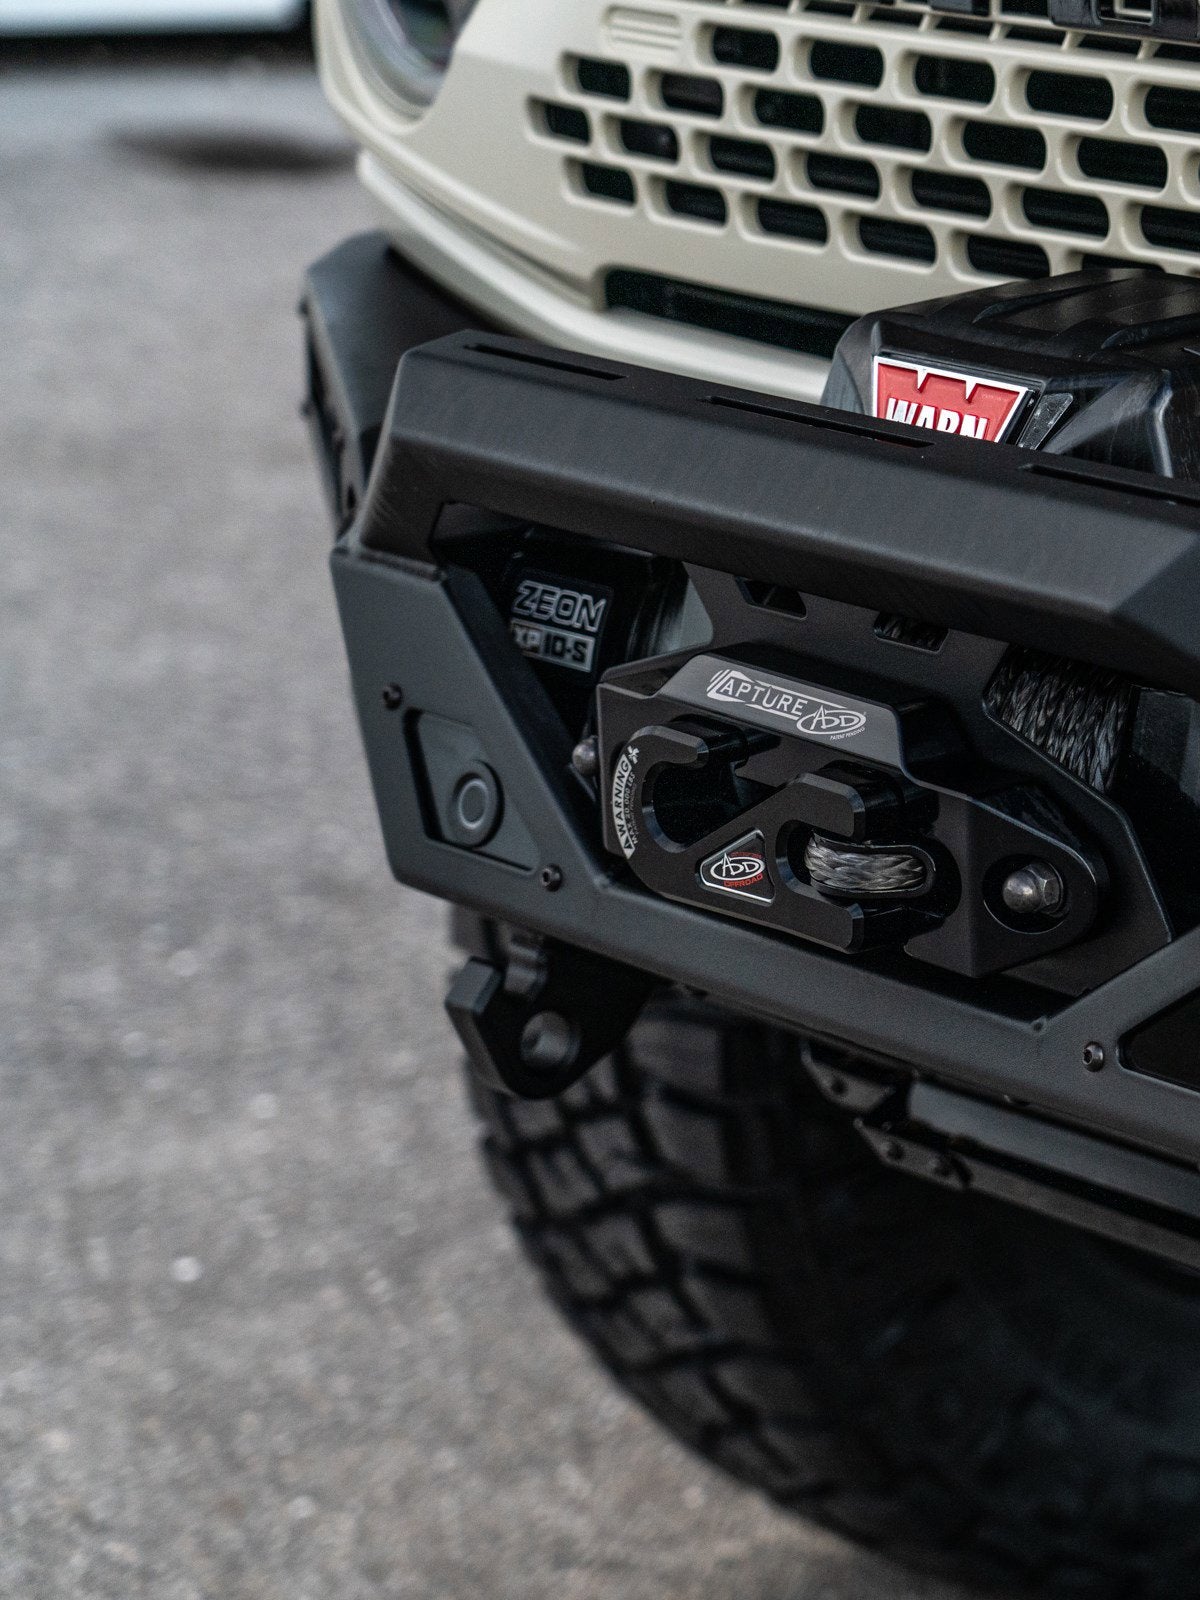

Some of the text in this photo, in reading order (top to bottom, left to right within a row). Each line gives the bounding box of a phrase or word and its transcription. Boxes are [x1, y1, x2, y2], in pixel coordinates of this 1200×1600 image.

[885, 397, 989, 440] WARN
[511, 579, 607, 633] ZEON
[614, 759, 629, 837] WARNING
[723, 872, 764, 888] OFFROAD
